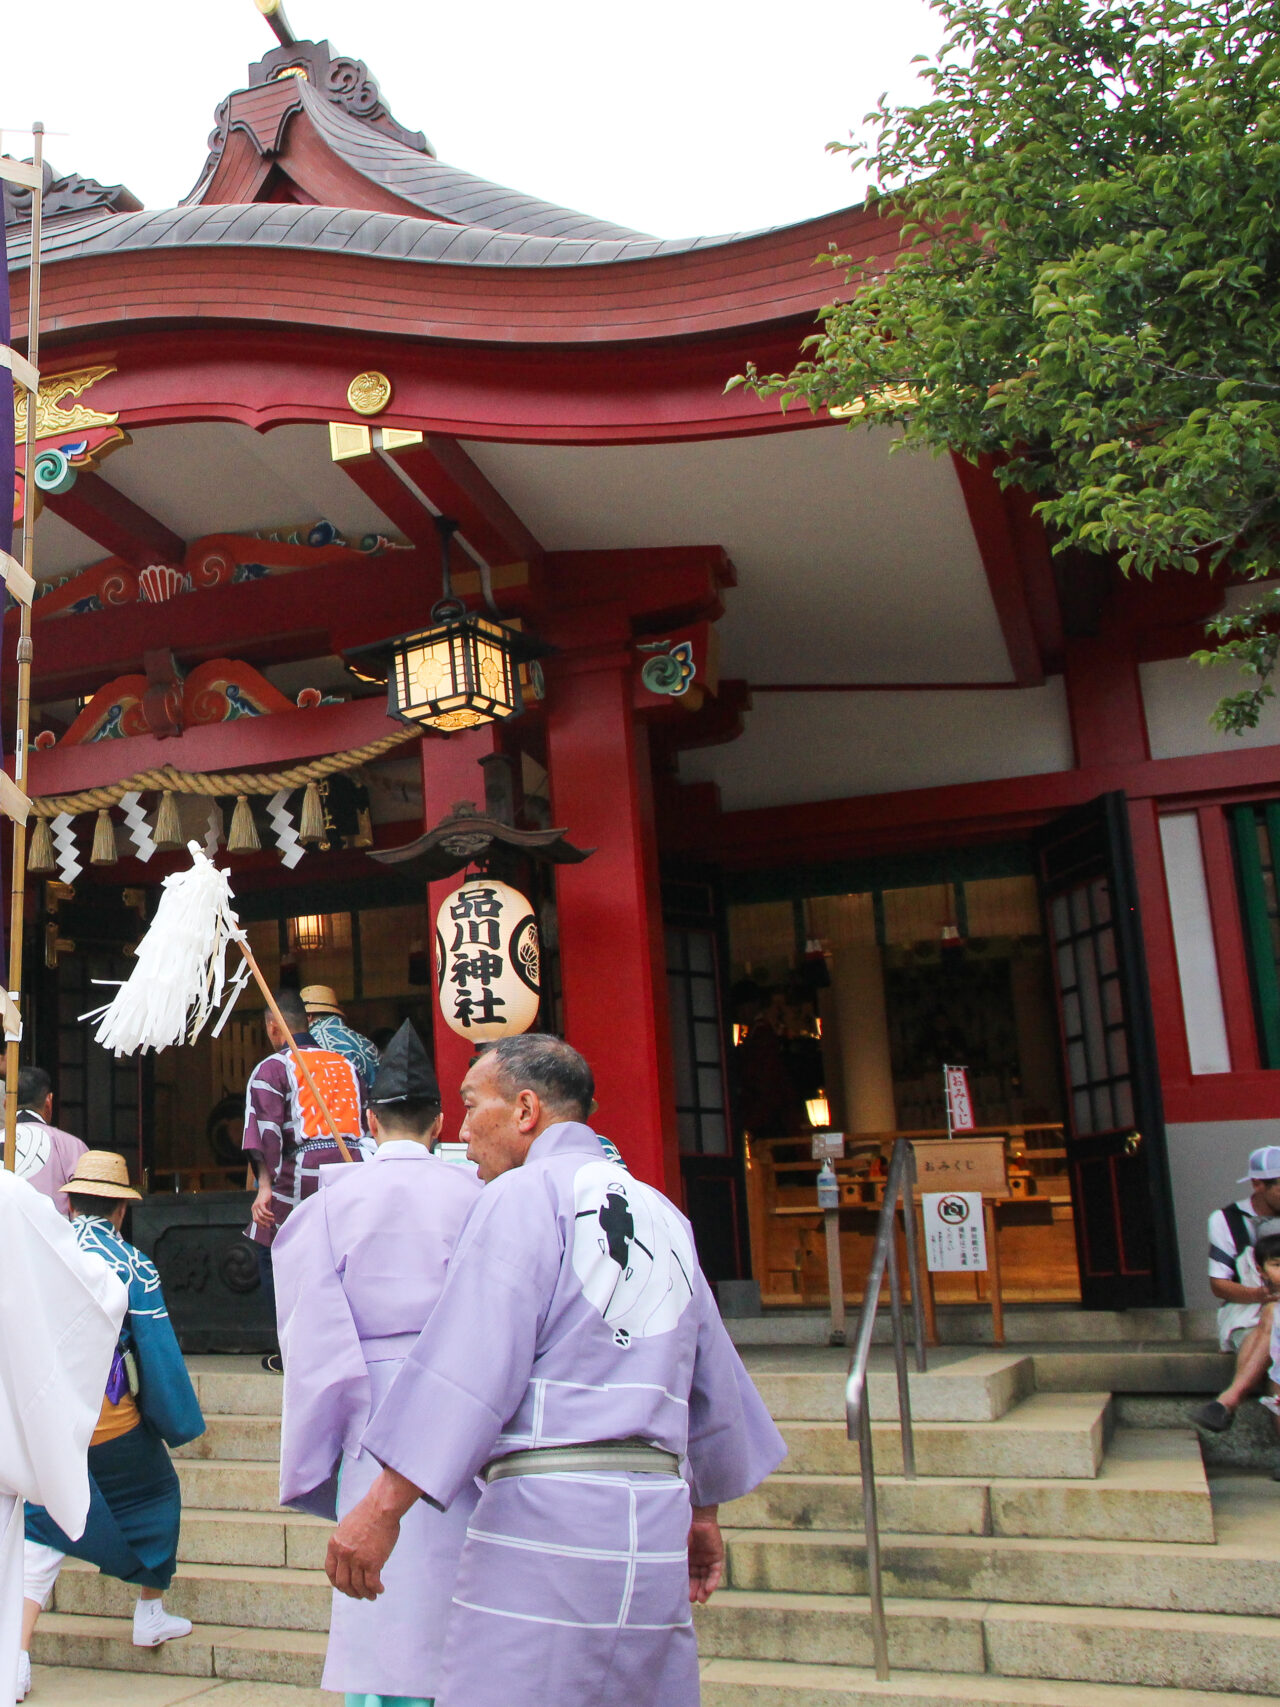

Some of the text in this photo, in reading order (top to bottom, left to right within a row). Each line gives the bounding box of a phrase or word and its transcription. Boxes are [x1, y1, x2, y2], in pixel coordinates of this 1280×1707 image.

[449, 888, 507, 1027] 品川神社
[952, 1076, 968, 1125] おみくじ
[925, 1161, 974, 1172] おみくじ
